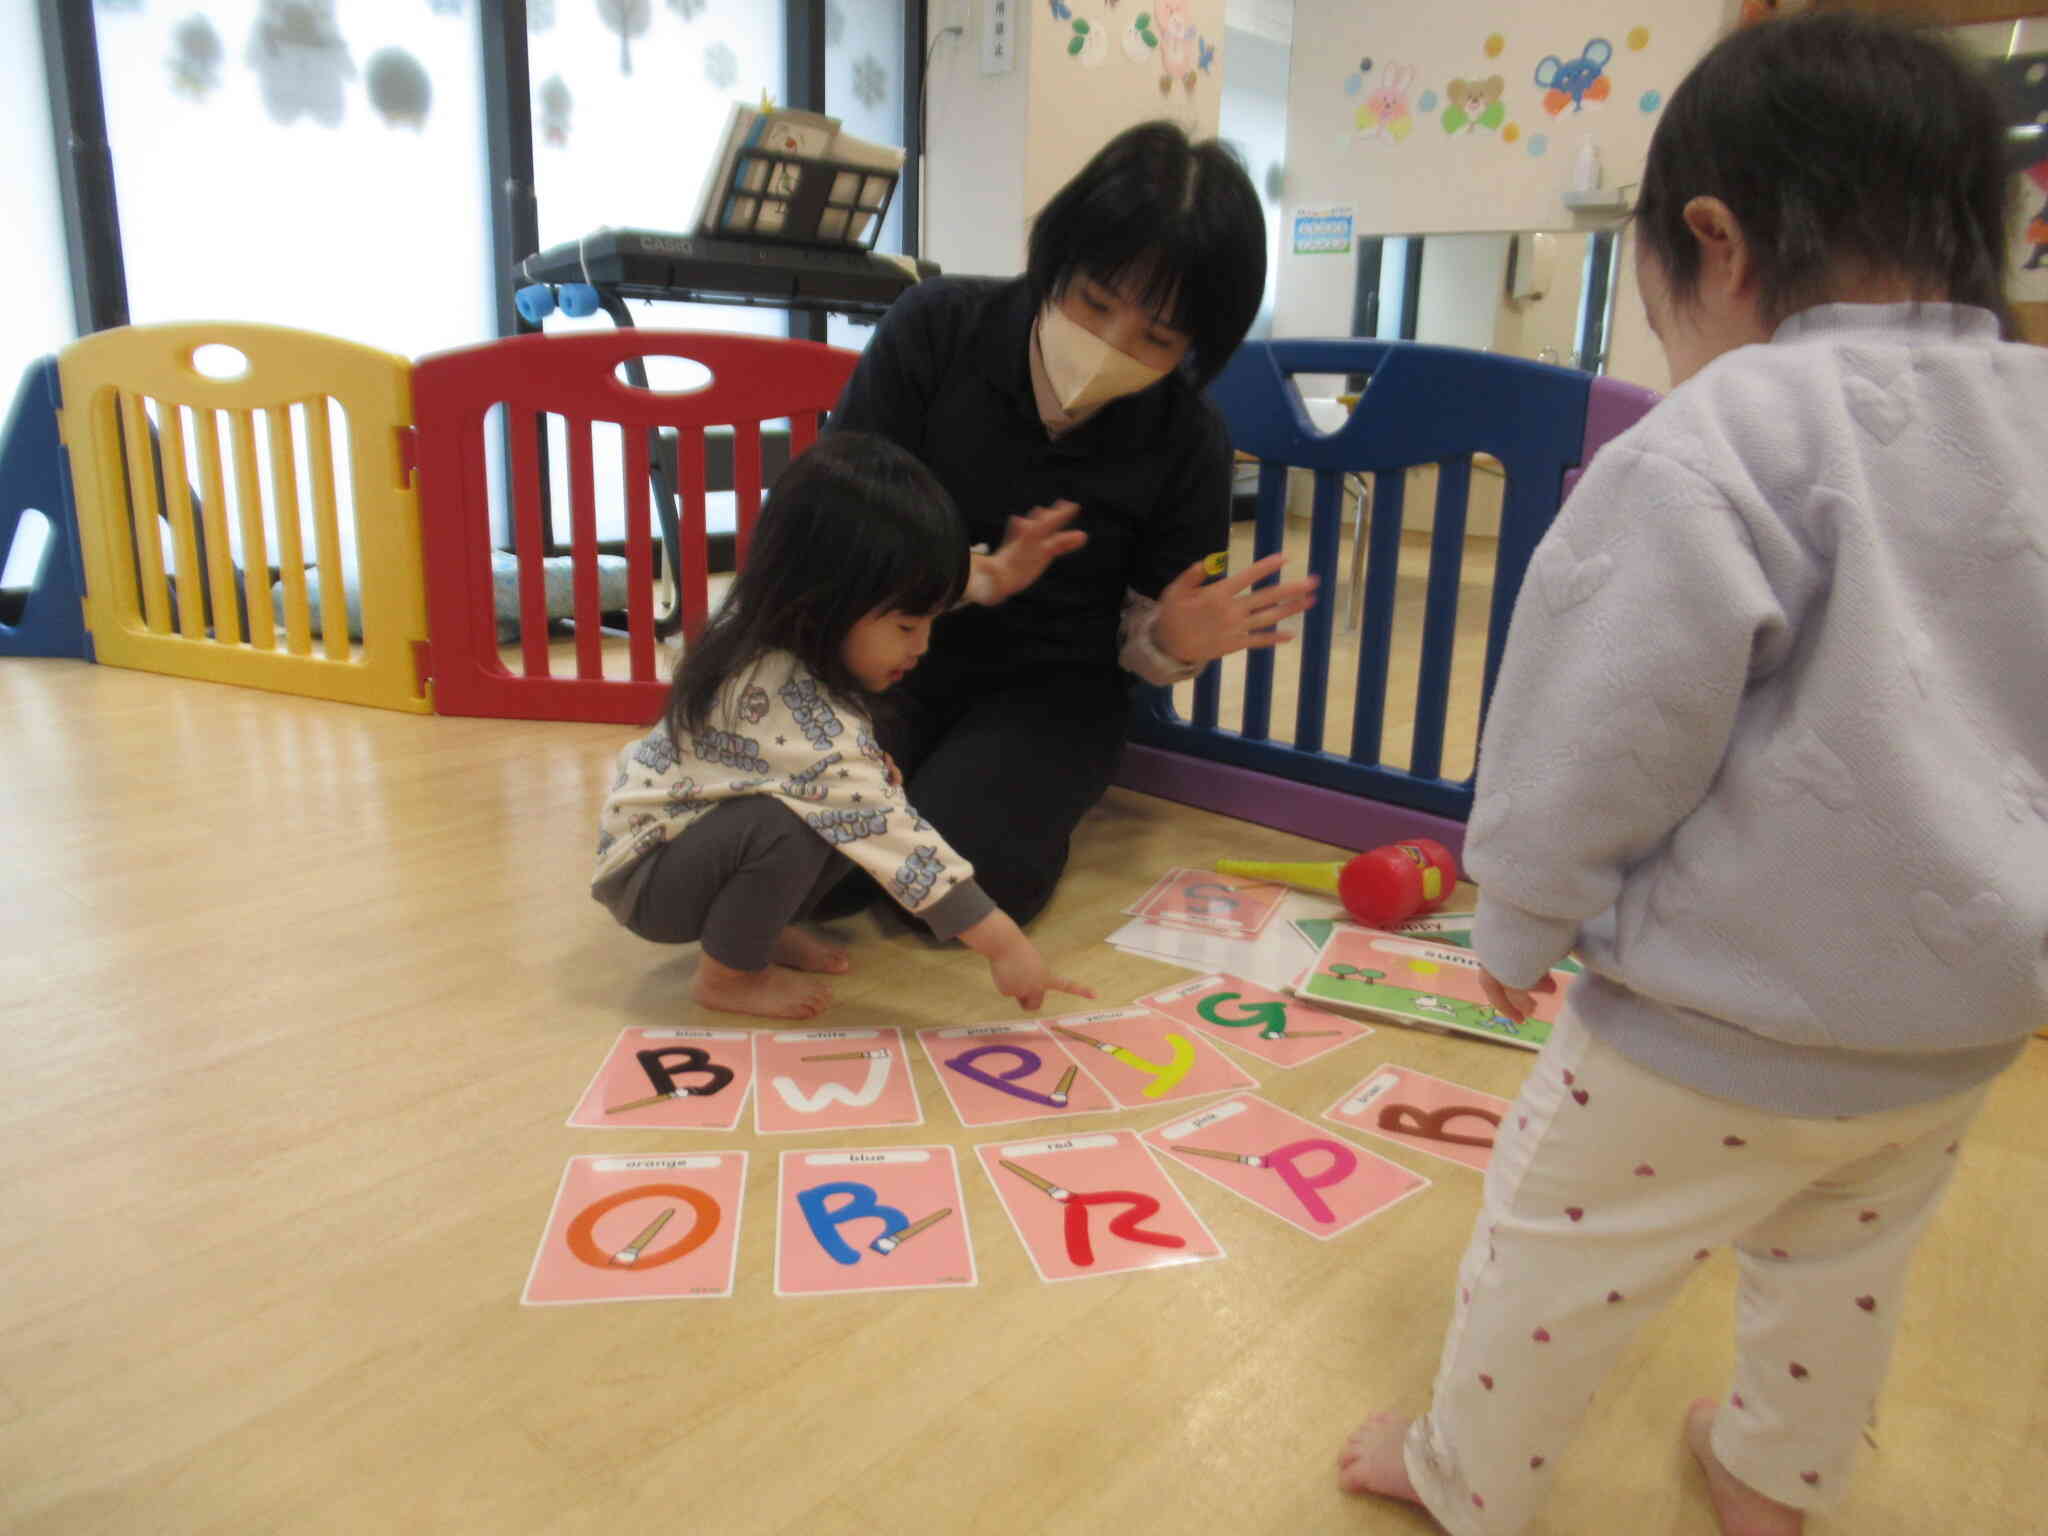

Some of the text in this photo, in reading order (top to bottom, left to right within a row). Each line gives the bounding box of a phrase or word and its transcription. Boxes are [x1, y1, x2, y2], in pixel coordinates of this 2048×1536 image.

[1423, 951, 1482, 968] sunn
[1197, 992, 1287, 1040] G
[636, 1046, 734, 1096] B
[772, 1051, 891, 1113] W
[944, 1045, 1067, 1109] P
[1113, 1034, 1195, 1099] Y
[1261, 1138, 1358, 1224] P
[565, 1183, 721, 1271] O
[1064, 1190, 1186, 1266] R
